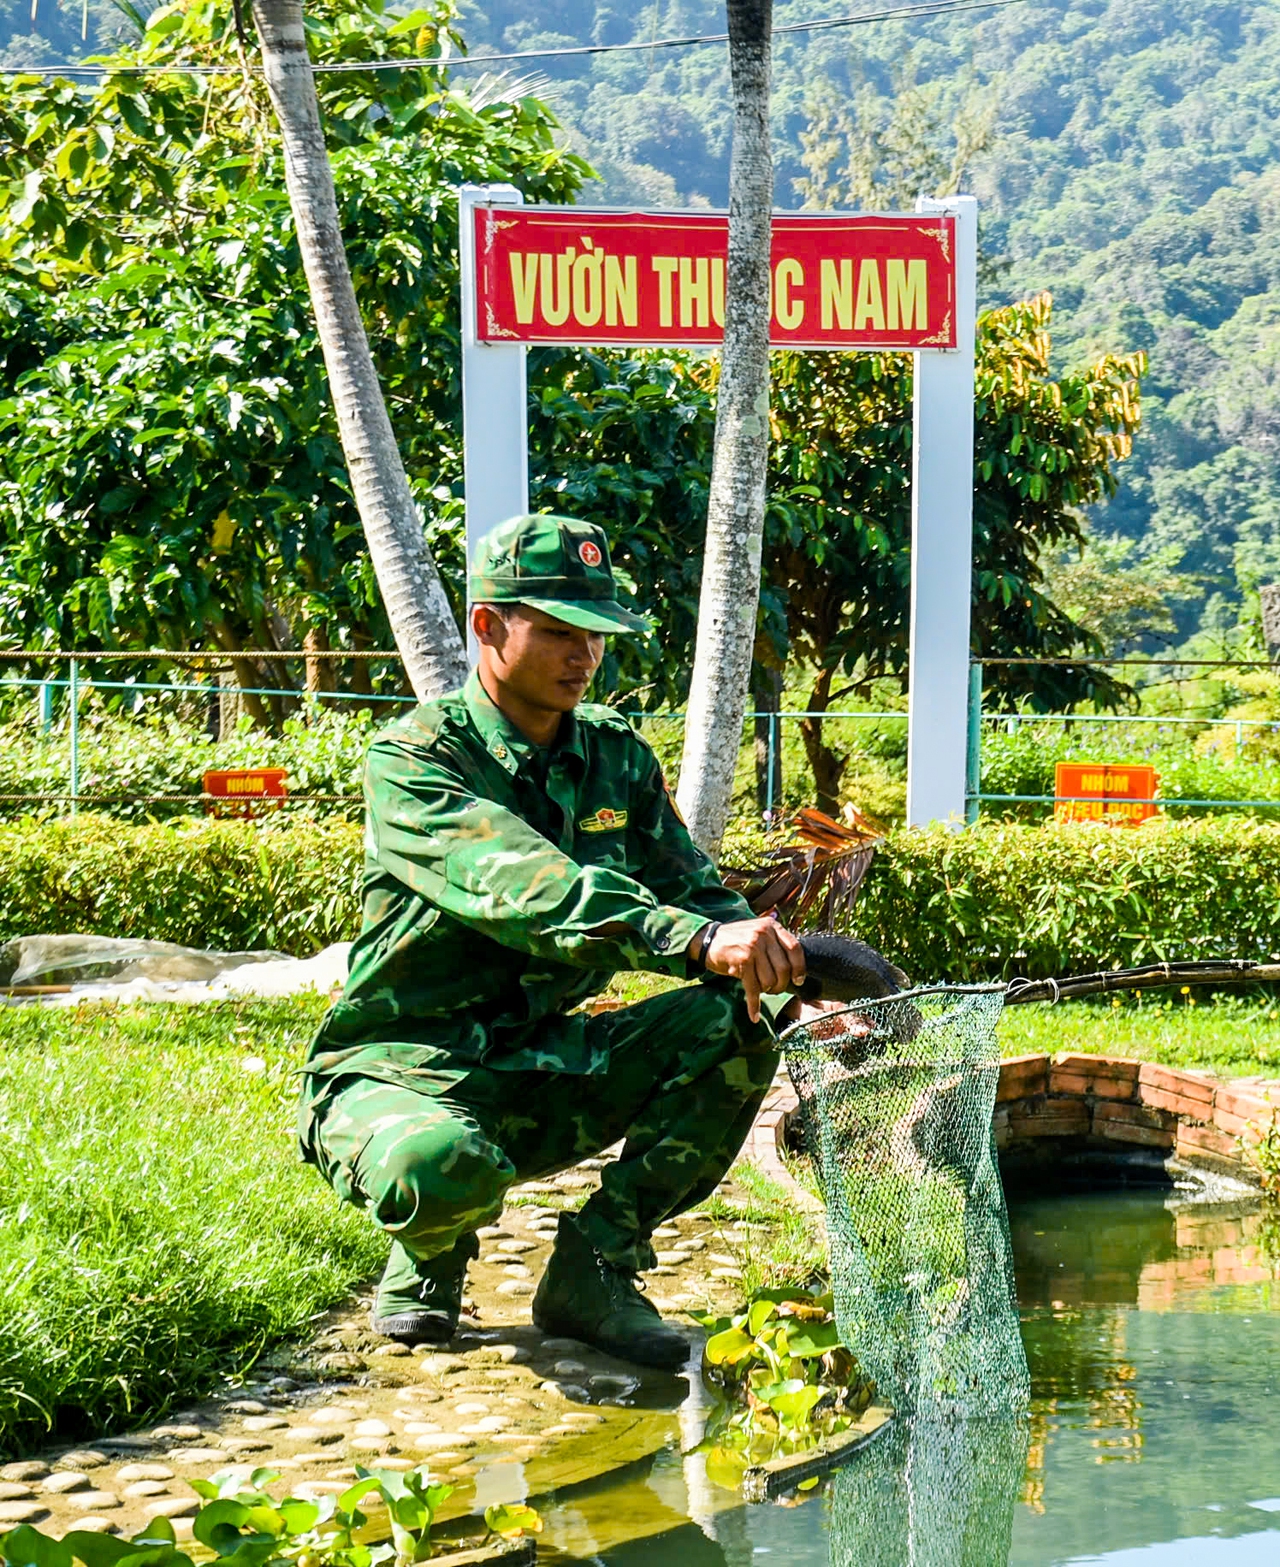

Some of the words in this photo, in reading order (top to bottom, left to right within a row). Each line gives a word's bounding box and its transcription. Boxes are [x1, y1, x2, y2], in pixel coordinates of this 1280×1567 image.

[509, 236, 638, 327] VƯỜN
[652, 234, 805, 330] THC
[820, 258, 928, 332] NAM
[1081, 771, 1129, 793] NHÓM
